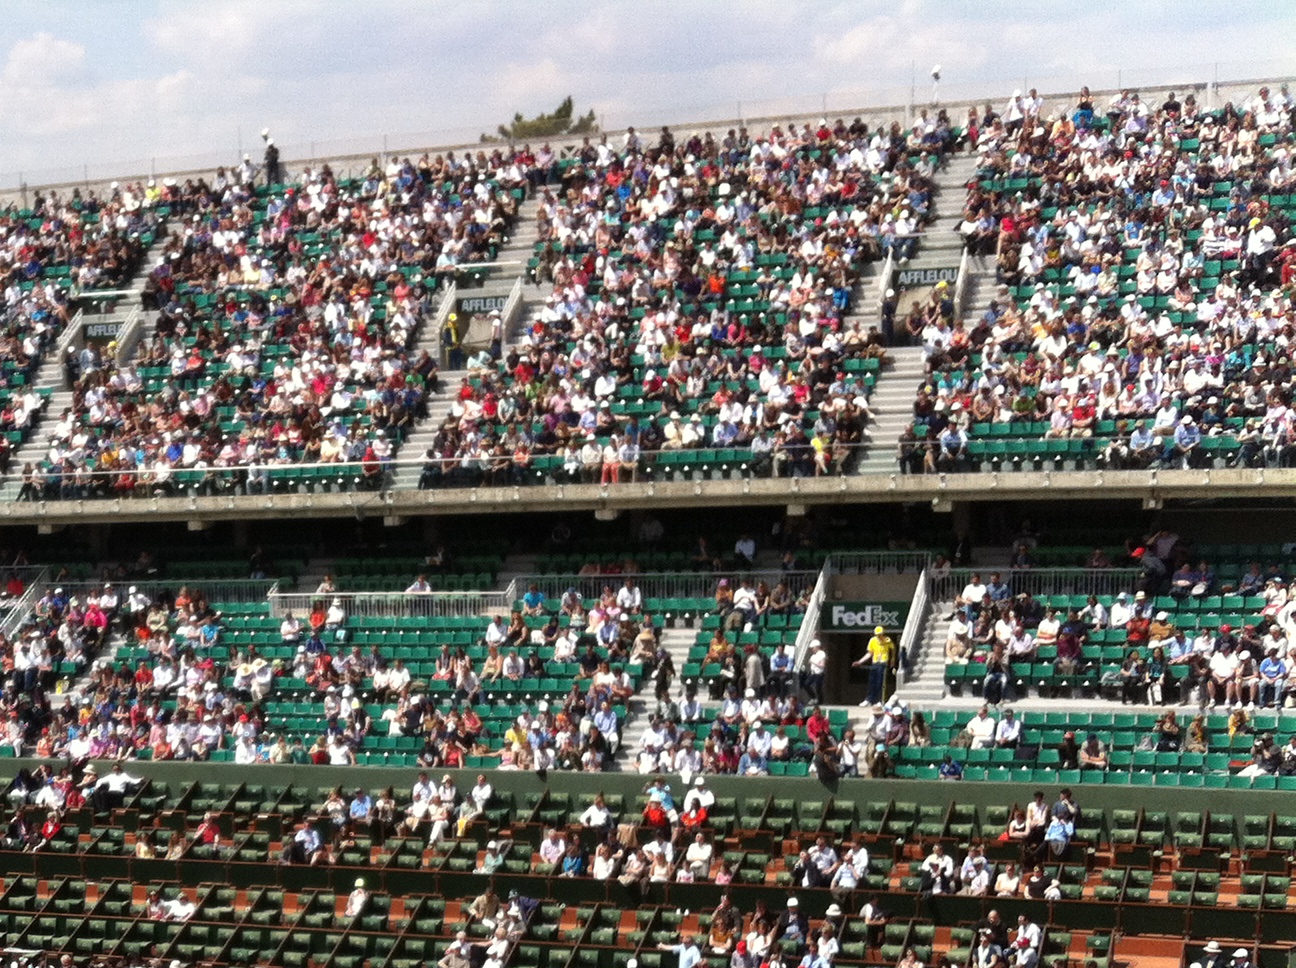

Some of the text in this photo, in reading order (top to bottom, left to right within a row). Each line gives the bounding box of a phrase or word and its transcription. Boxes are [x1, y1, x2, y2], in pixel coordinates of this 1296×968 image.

[898, 269, 957, 284] AFFLELOU
[461, 297, 509, 312] AFFLELO
[832, 604, 899, 627] FedEx
